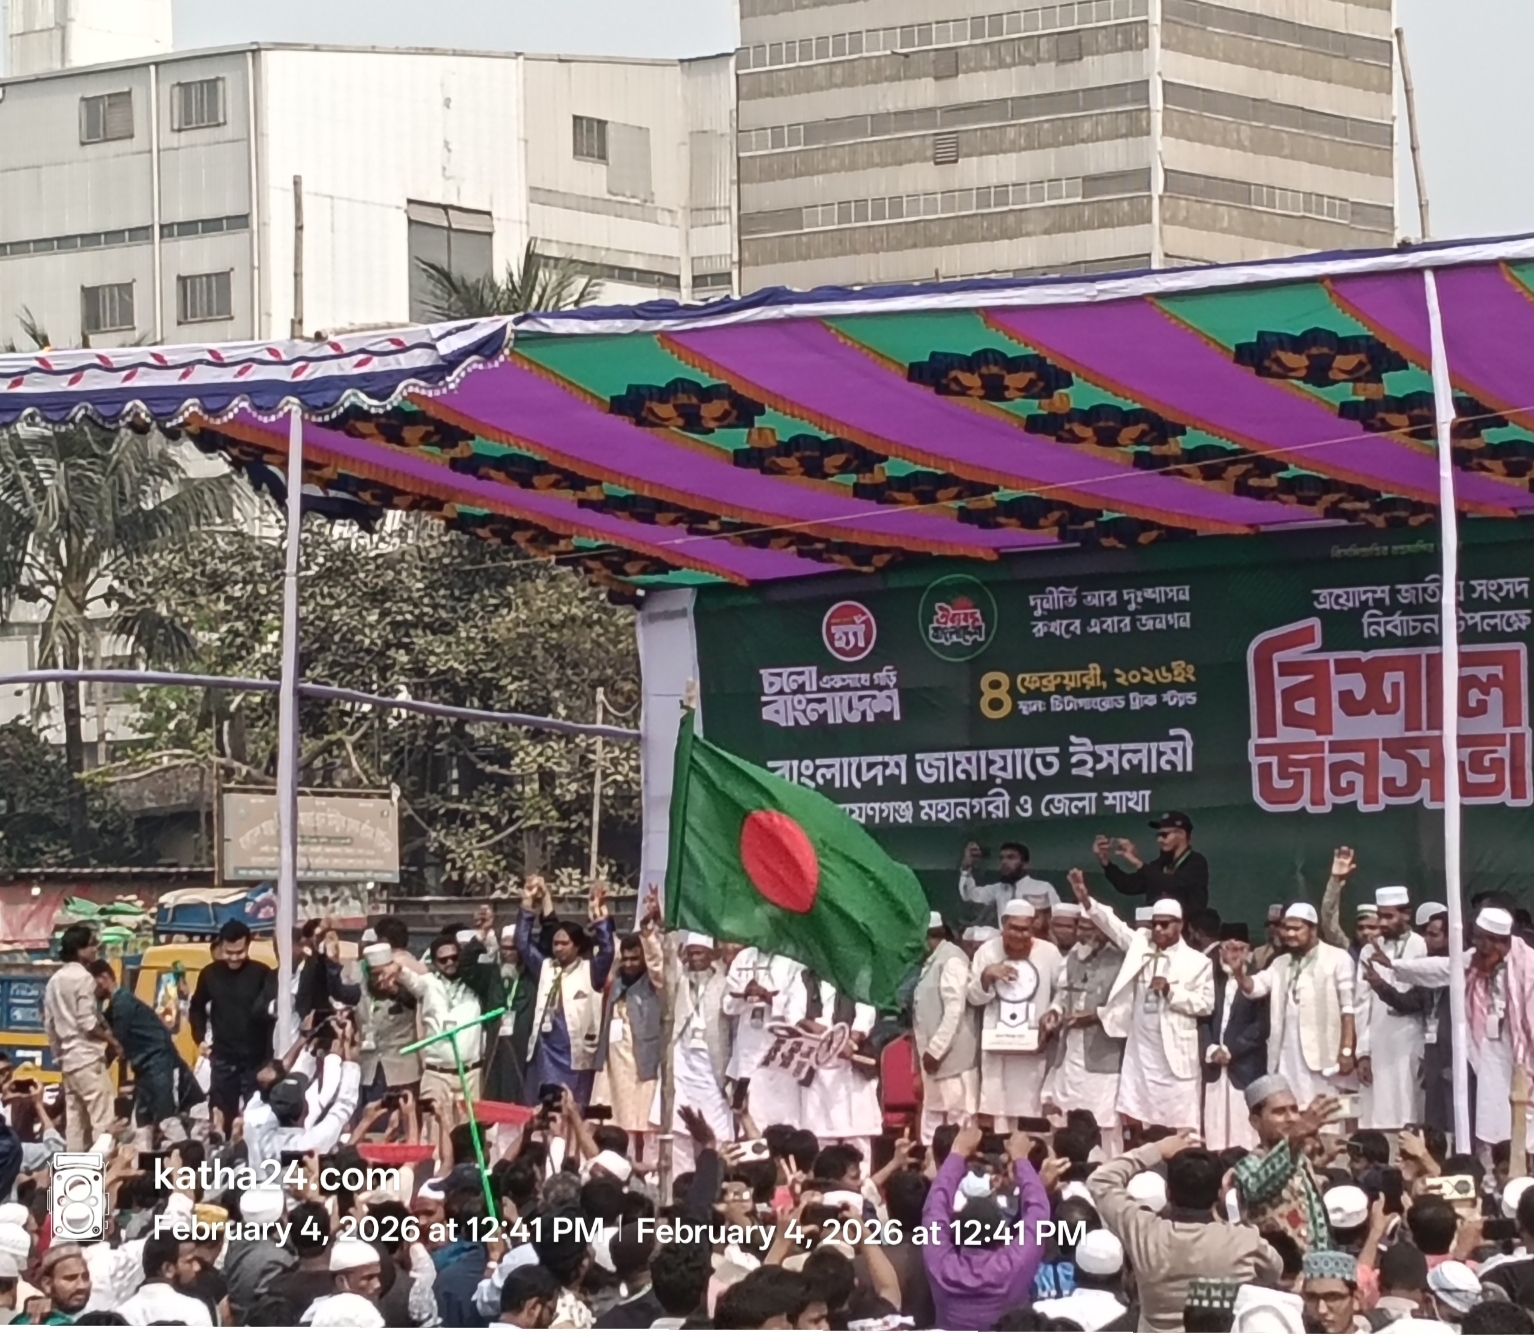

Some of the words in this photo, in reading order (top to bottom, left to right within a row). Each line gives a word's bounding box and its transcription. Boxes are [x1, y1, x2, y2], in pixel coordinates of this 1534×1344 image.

[1082, 588, 1118, 607] আর
[1311, 585, 1391, 611] ত্রয়োদশ
[1469, 576, 1531, 603] সংসদ
[1030, 617, 1082, 639] রুখবে
[1086, 615, 1132, 634] এবার
[1361, 608, 1440, 639] নির্বাচন
[759, 665, 818, 694] চলো
[1247, 617, 1528, 742] বিশাল
[760, 687, 901, 728] বাংলাদেশ
[766, 754, 908, 790] বাংলাদেশ
[914, 746, 1061, 785] জামায়াতে
[1068, 727, 1195, 779] ইসলামী
[1248, 731, 1534, 813] জনসভা
[918, 787, 1011, 823] মহানগরী
[1015, 794, 1034, 818] ও
[1040, 791, 1098, 817] জেলা
[1101, 789, 1152, 814] শাখা
